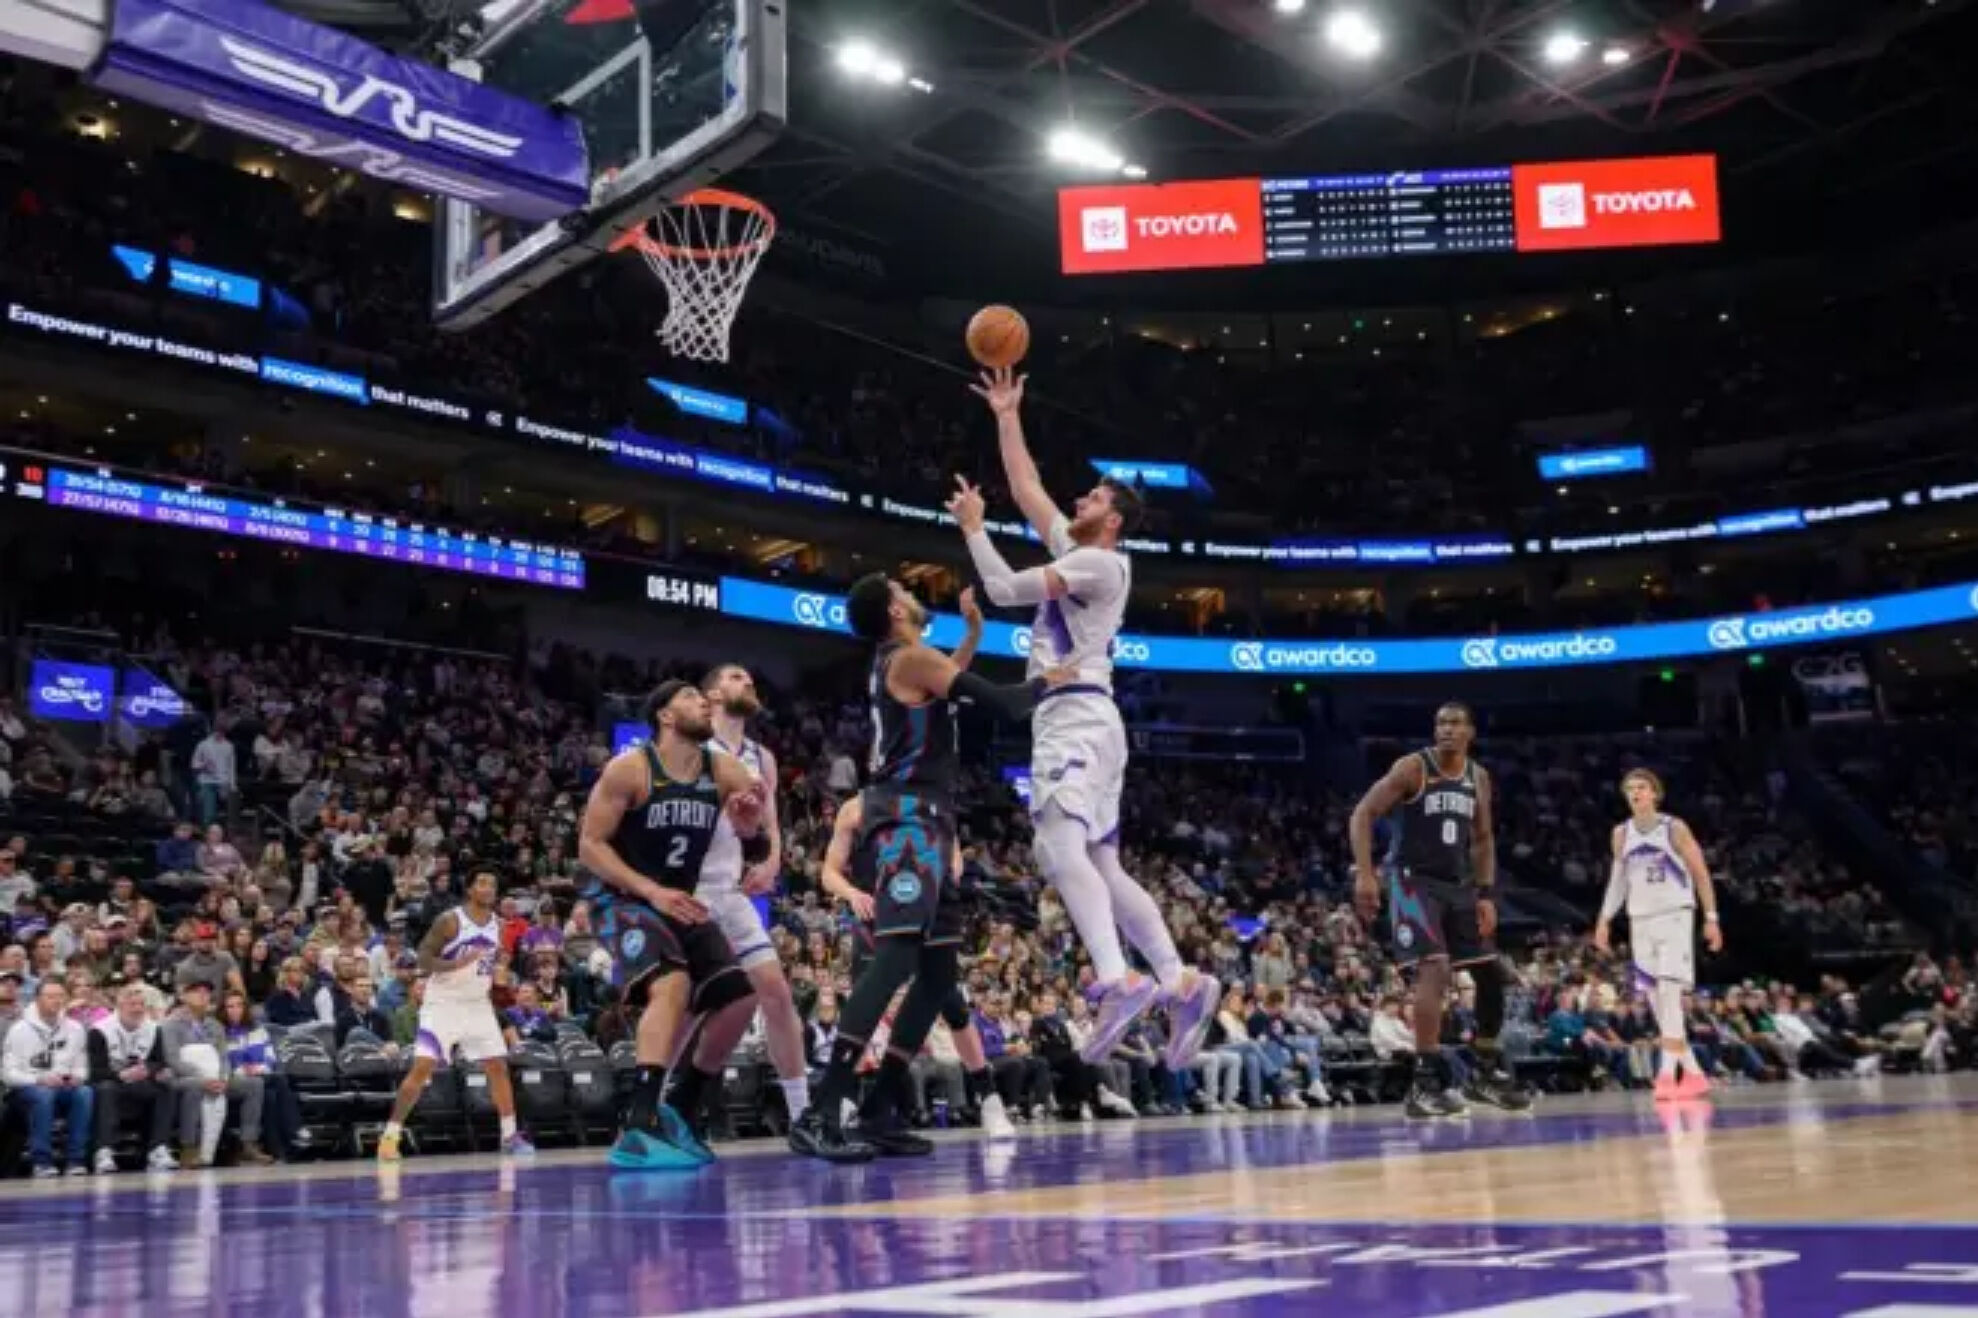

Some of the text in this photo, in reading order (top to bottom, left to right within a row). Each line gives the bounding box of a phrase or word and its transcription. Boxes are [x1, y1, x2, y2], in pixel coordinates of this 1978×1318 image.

[1592, 189, 1697, 214] TOYOTA
[1134, 213, 1238, 238] TOYOTA
[8, 303, 470, 420] Empower your teams with recognition that matters
[515, 416, 586, 445] Empower
[587, 436, 619, 452] your
[620, 442, 664, 463] teams
[665, 453, 694, 468] with
[776, 475, 801, 492] that
[803, 483, 849, 503] matters
[692, 582, 718, 610] PM
[1750, 607, 1874, 639] awardco
[1266, 644, 1376, 667] awardco
[1500, 637, 1616, 662] awardco
[646, 799, 718, 831] DETROIT
[1424, 791, 1476, 820] DETROIT
[1442, 819, 1458, 845] 0
[665, 835, 690, 868] 2
